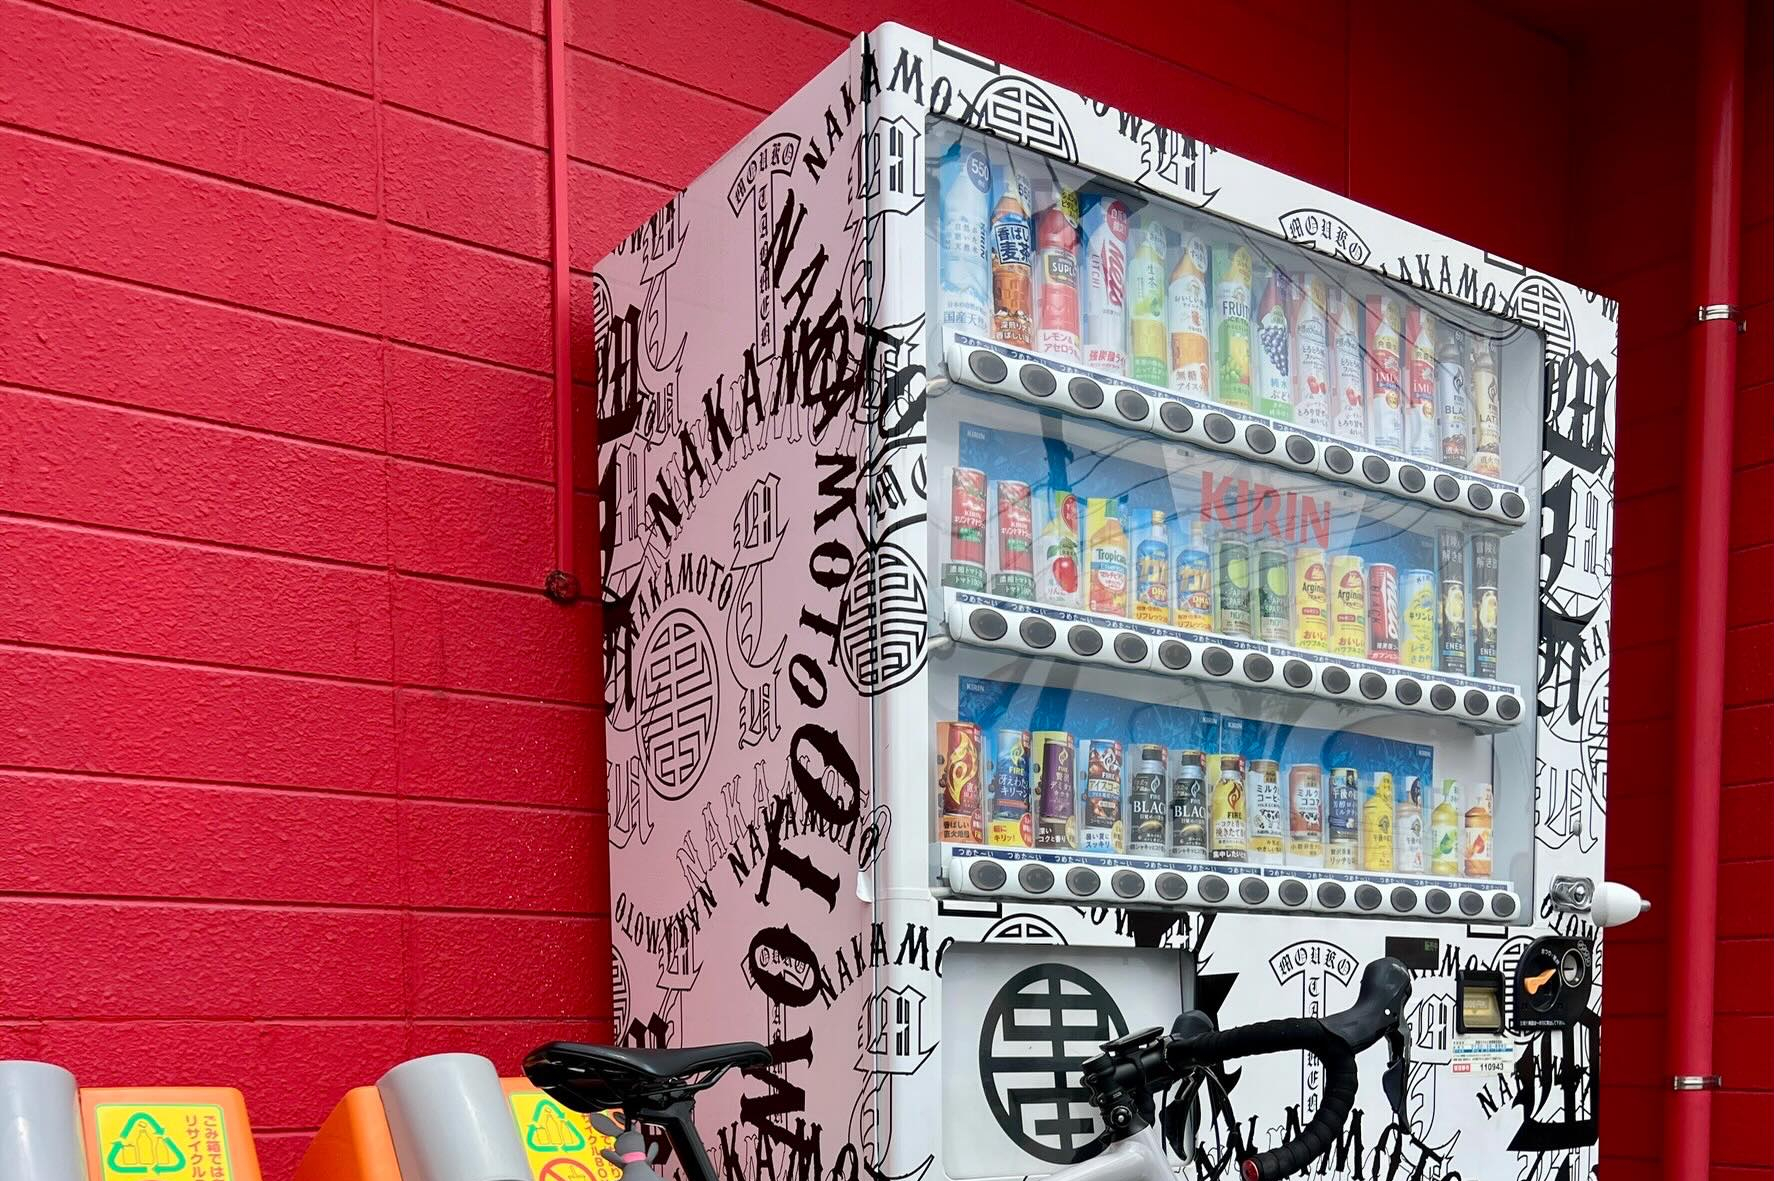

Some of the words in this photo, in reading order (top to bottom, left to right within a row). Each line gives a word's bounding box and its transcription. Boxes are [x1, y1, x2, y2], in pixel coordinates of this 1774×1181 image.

[1000, 241, 1031, 261] 麦茶
[1289, 215, 1363, 262] MOUKO
[1200, 471, 1331, 550] KIRIN
[1257, 794, 1280, 803] コーヒ
[1278, 946, 1352, 978] MOUKO
[1307, 976, 1321, 1113] TAMEN
[1480, 1062, 1504, 1071] 110943
